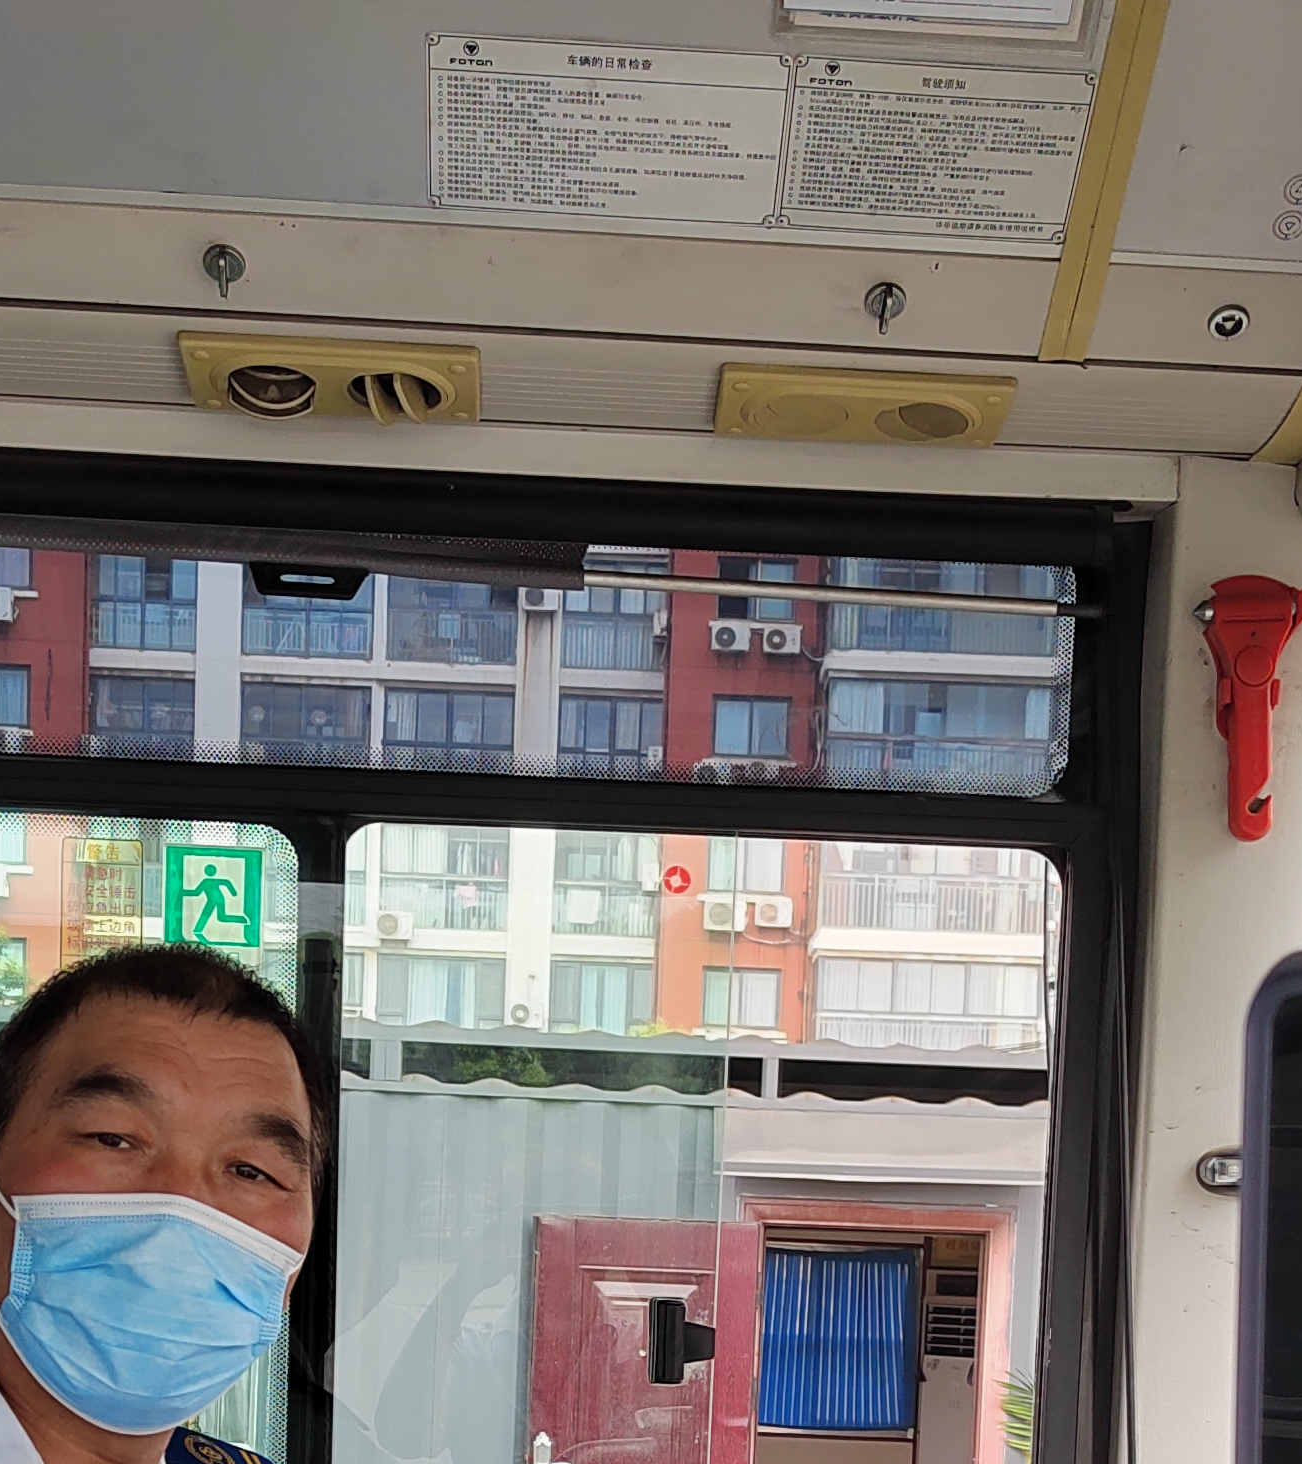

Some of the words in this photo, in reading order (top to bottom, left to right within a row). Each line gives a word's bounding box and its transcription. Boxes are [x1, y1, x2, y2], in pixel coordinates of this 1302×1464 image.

[449, 57, 493, 67] FOTON
[566, 54, 654, 72] 车辆的日常检查
[809, 77, 852, 87] FOTON
[921, 76, 967, 91] 驾驶须知
[87, 842, 121, 861] 警告
